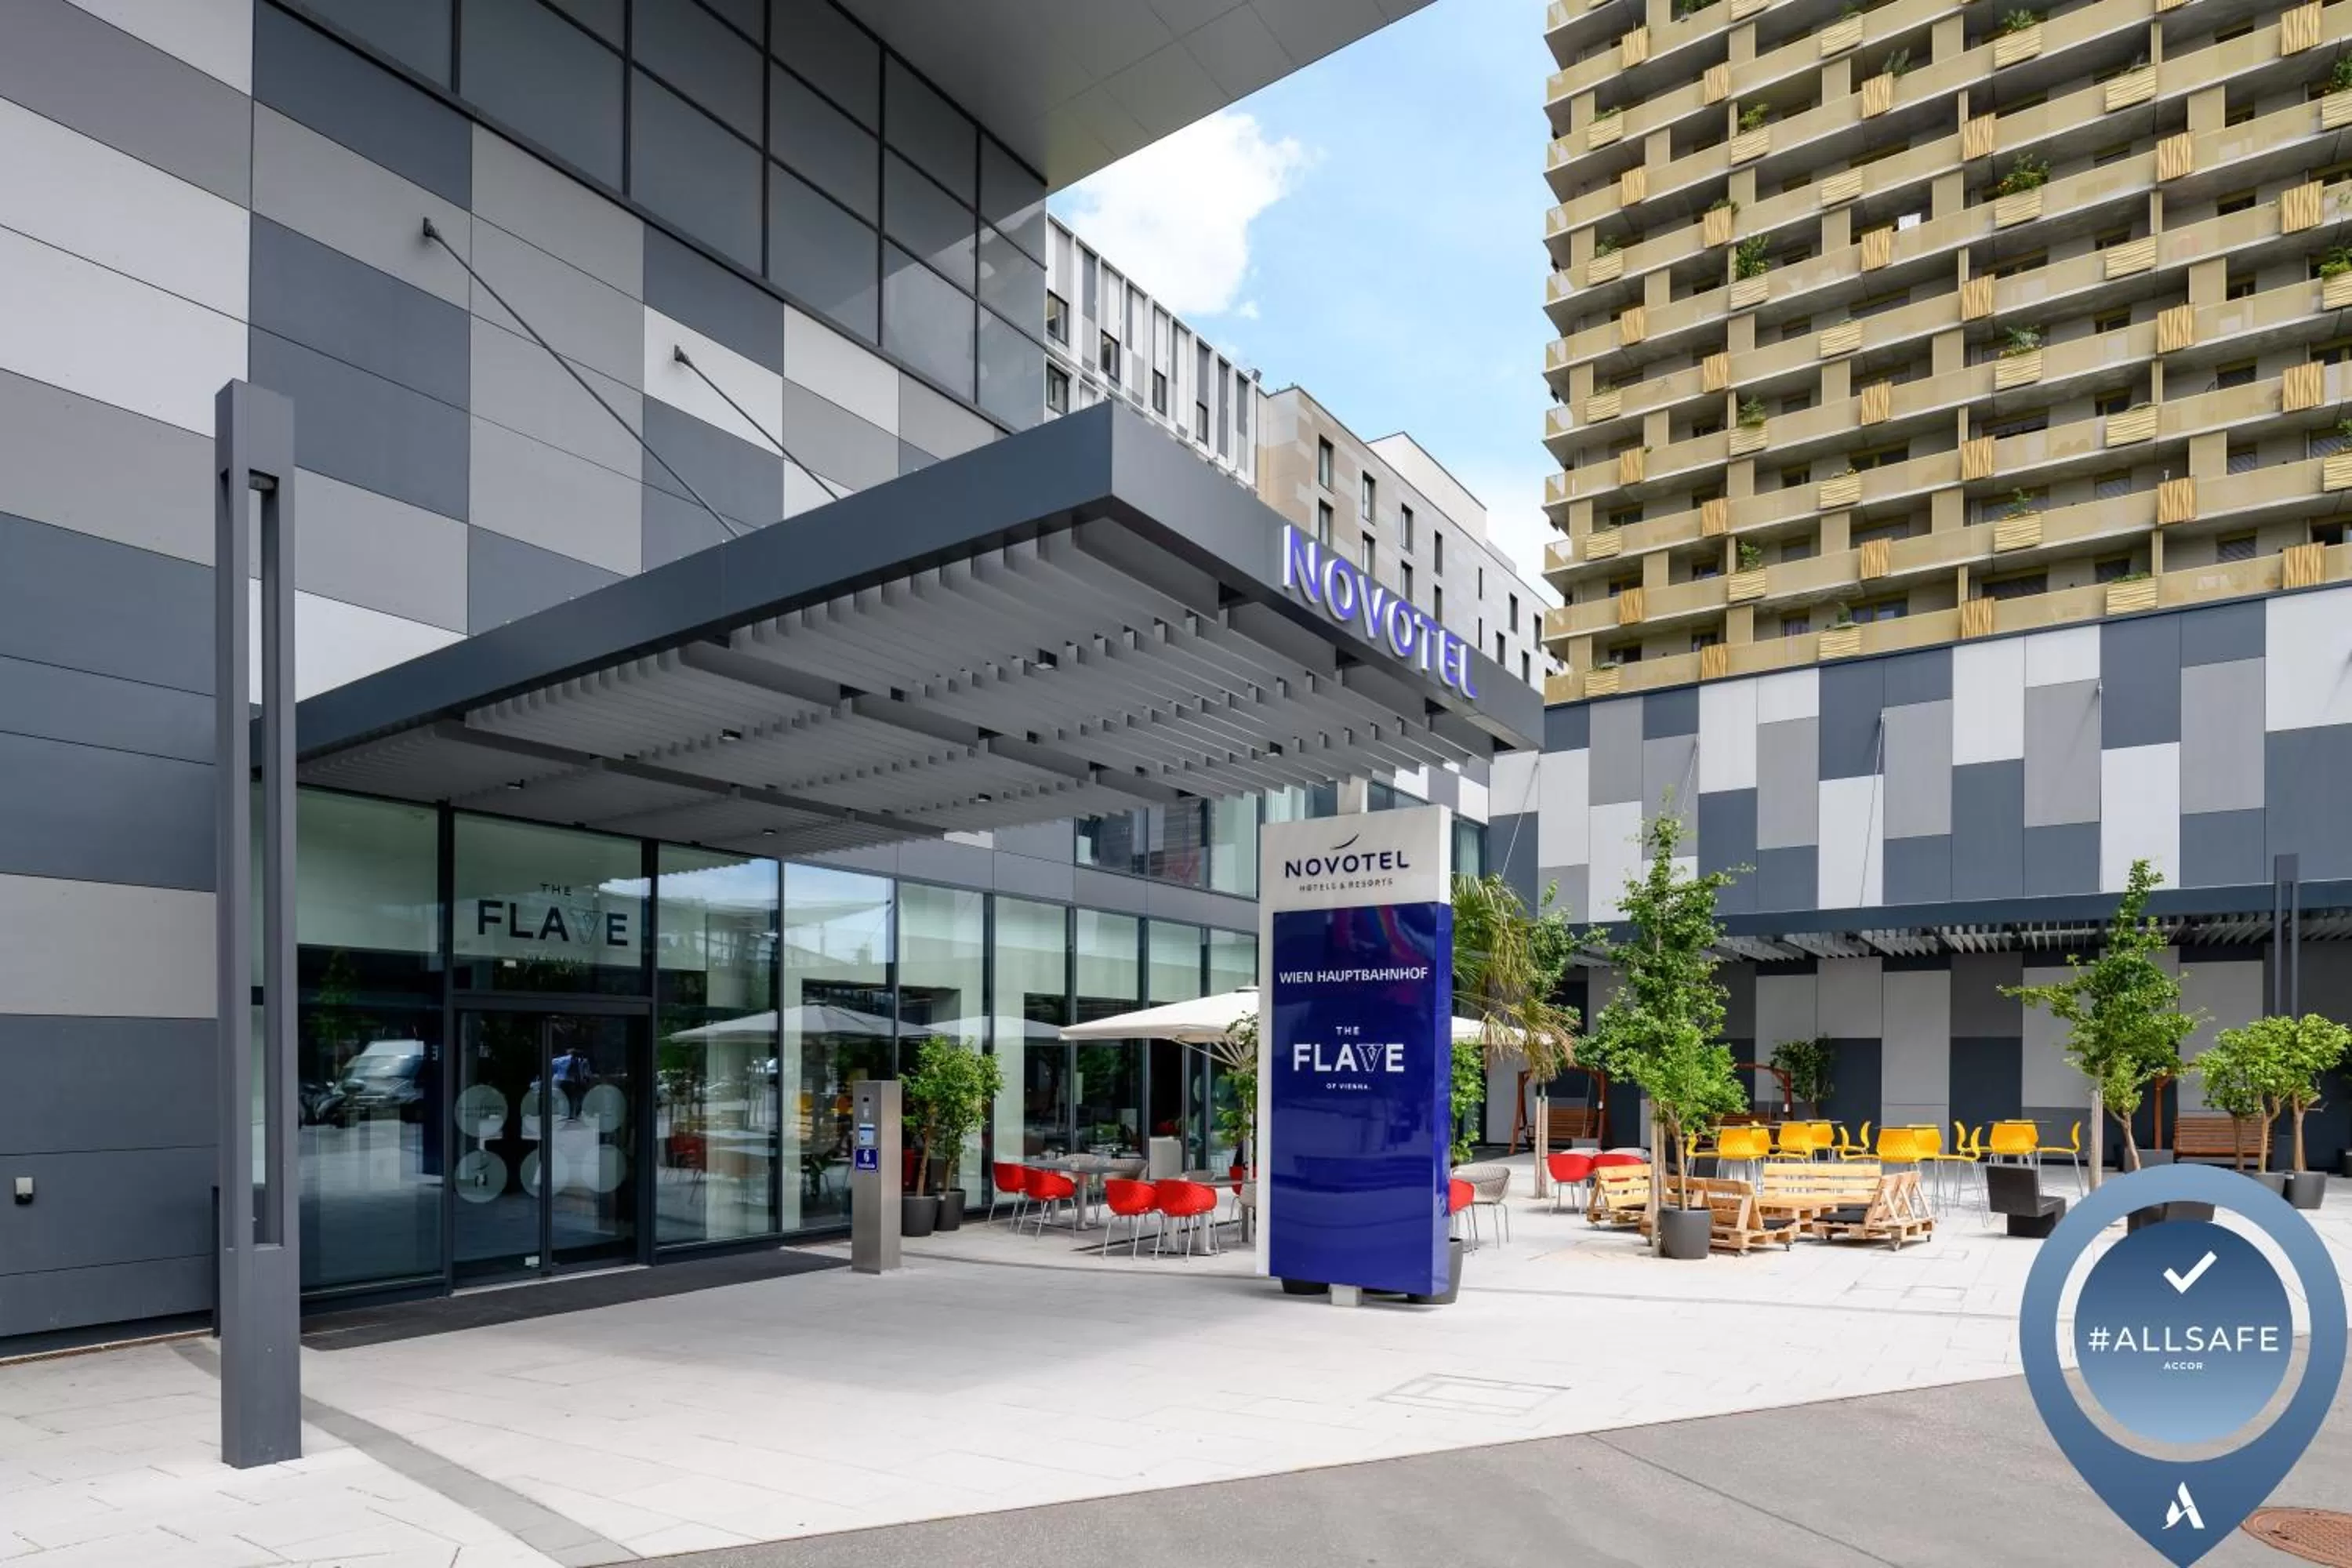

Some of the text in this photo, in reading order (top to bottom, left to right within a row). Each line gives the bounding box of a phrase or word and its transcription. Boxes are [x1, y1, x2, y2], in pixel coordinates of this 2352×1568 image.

[1283, 524, 1478, 699] NOVOTEL
[1284, 851, 1410, 879] NOVOTEL
[540, 883, 572, 896] THE
[1299, 882, 1337, 892] HOTELS
[1348, 877, 1394, 888] RESORTS
[477, 899, 628, 946] FLAVE
[1279, 967, 1428, 984] WIEN HAUPTBAHNHOF
[1335, 1025, 1360, 1036] THE
[1294, 1044, 1405, 1073] FLAVE
